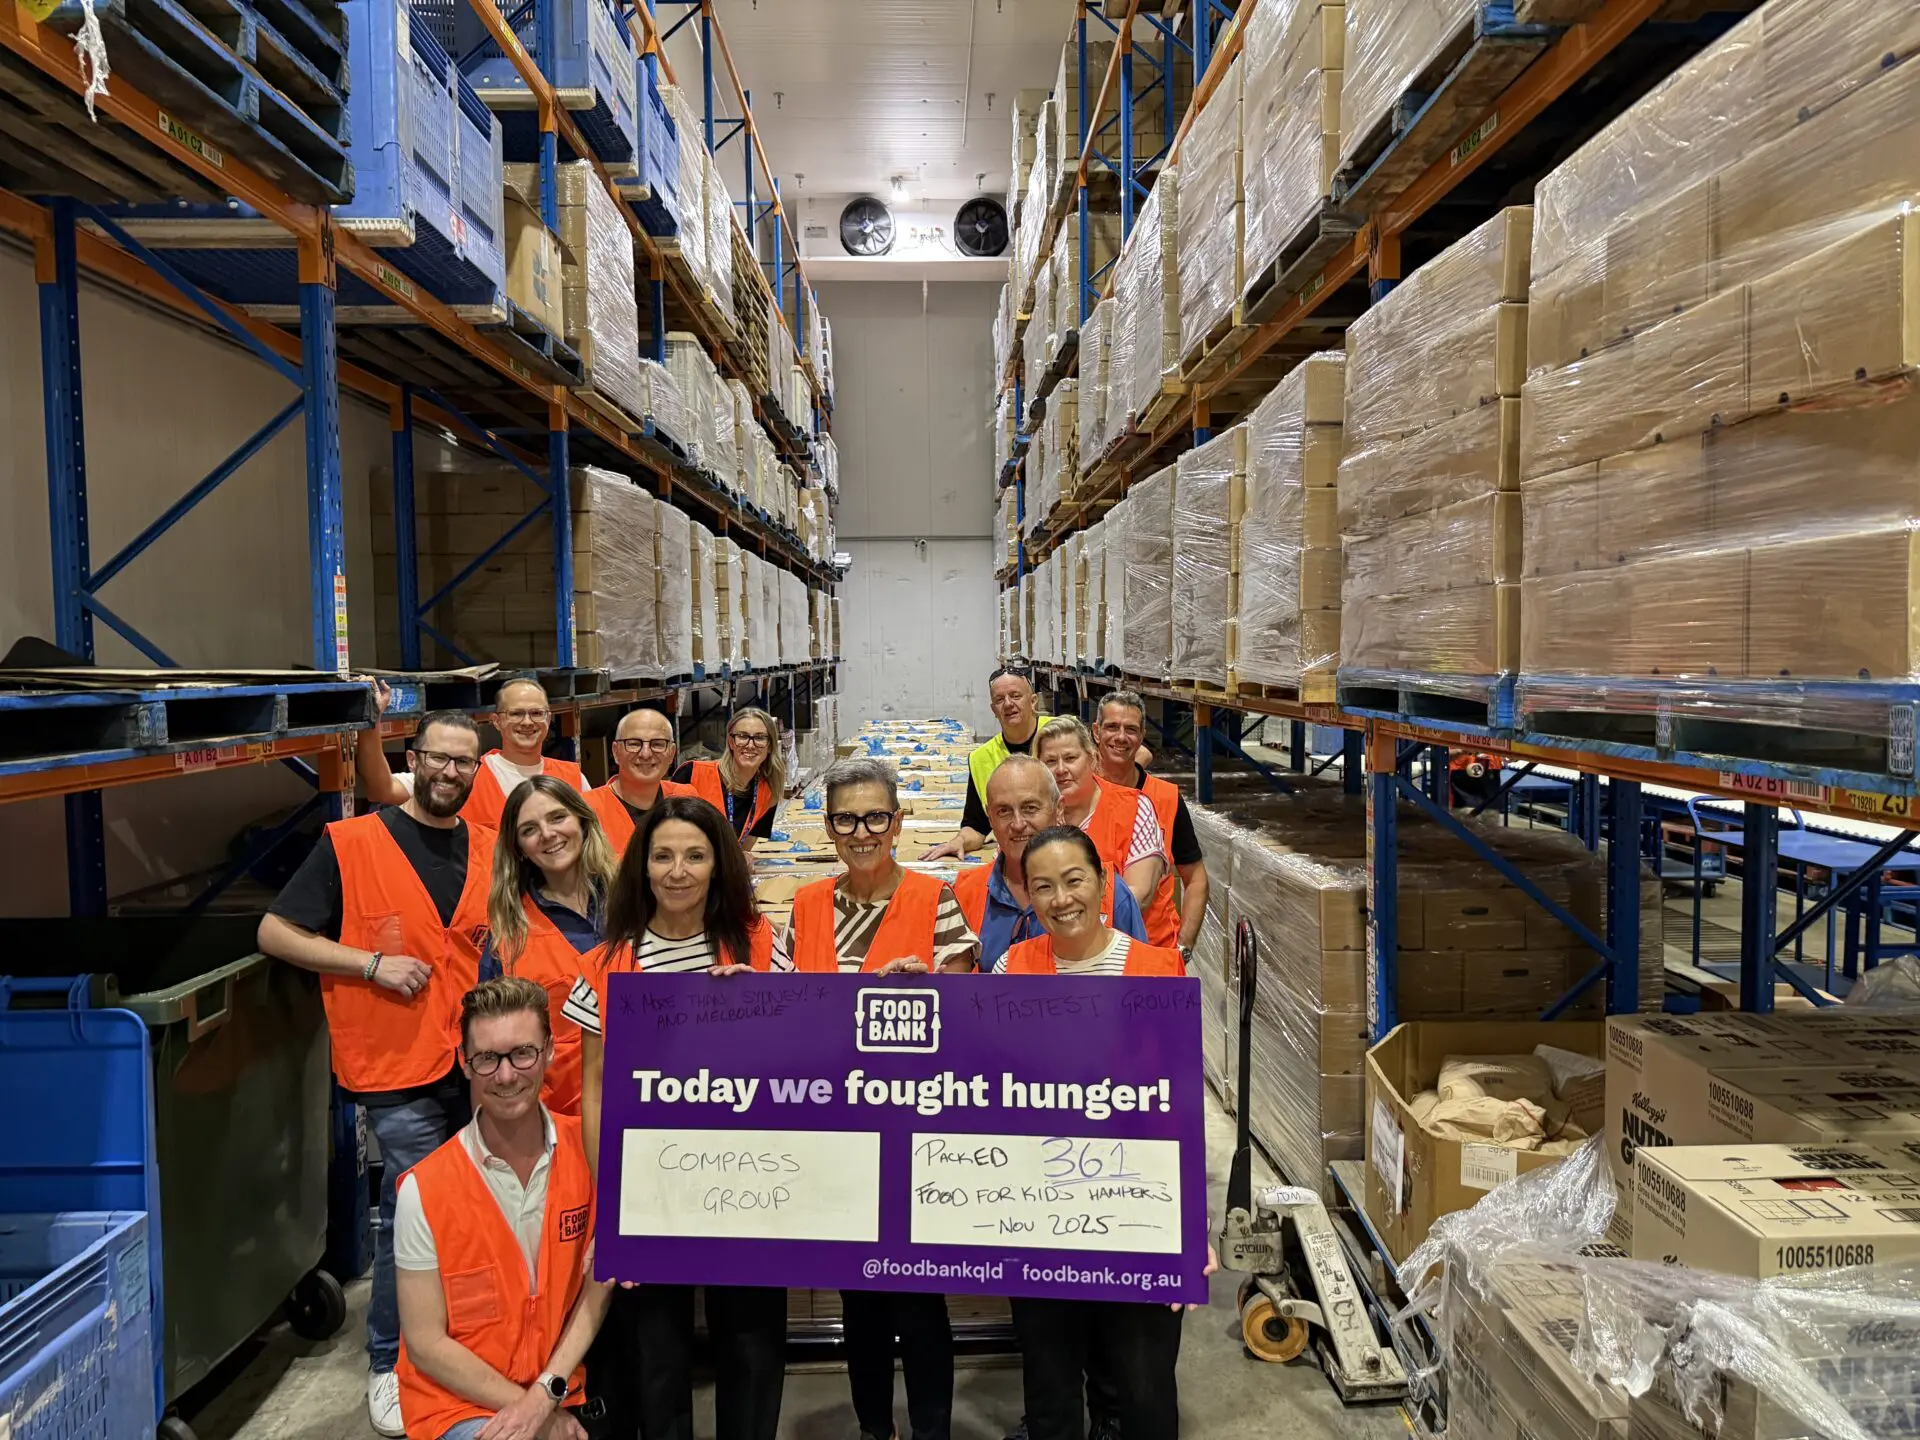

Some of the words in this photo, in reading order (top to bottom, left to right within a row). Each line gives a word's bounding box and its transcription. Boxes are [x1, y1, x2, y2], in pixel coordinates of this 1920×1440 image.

[185, 752, 192, 765] A
[193, 750, 204, 764] 01
[206, 748, 218, 761] B2
[1732, 772, 1743, 787] A
[1748, 774, 1762, 790] 02
[1767, 776, 1785, 794] B1
[687, 991, 726, 1007] THAN
[869, 999, 927, 1021] FOOD
[994, 991, 1102, 1025] FASTEST
[656, 1012, 688, 1030] AND
[696, 1004, 788, 1025] MELBOURNE
[869, 1021, 927, 1041] BANK
[632, 1068, 760, 1113] Today
[768, 1078, 833, 1105] we
[844, 1070, 989, 1116] fought
[1002, 1072, 1171, 1121] hunger!
[1709, 1081, 1754, 1120] 1005510688
[658, 1143, 801, 1174] COMPASS
[915, 1138, 1009, 1168] PACKED
[1041, 1136, 1142, 1179] 361
[976, 1186, 1016, 1202] FOR
[1022, 1185, 1075, 1202] KIDS
[1088, 1186, 1173, 1202] HAMPERS
[1637, 1161, 1686, 1213] 1005510688
[703, 1186, 791, 1215] GROUP
[565, 1210, 587, 1226] FOOD
[1048, 1213, 1116, 1236] 2025
[1776, 1244, 1874, 1269] 1005510688
[862, 1257, 1003, 1283] @foodbankqld
[1022, 1263, 1182, 1291] foodbank.org.au
